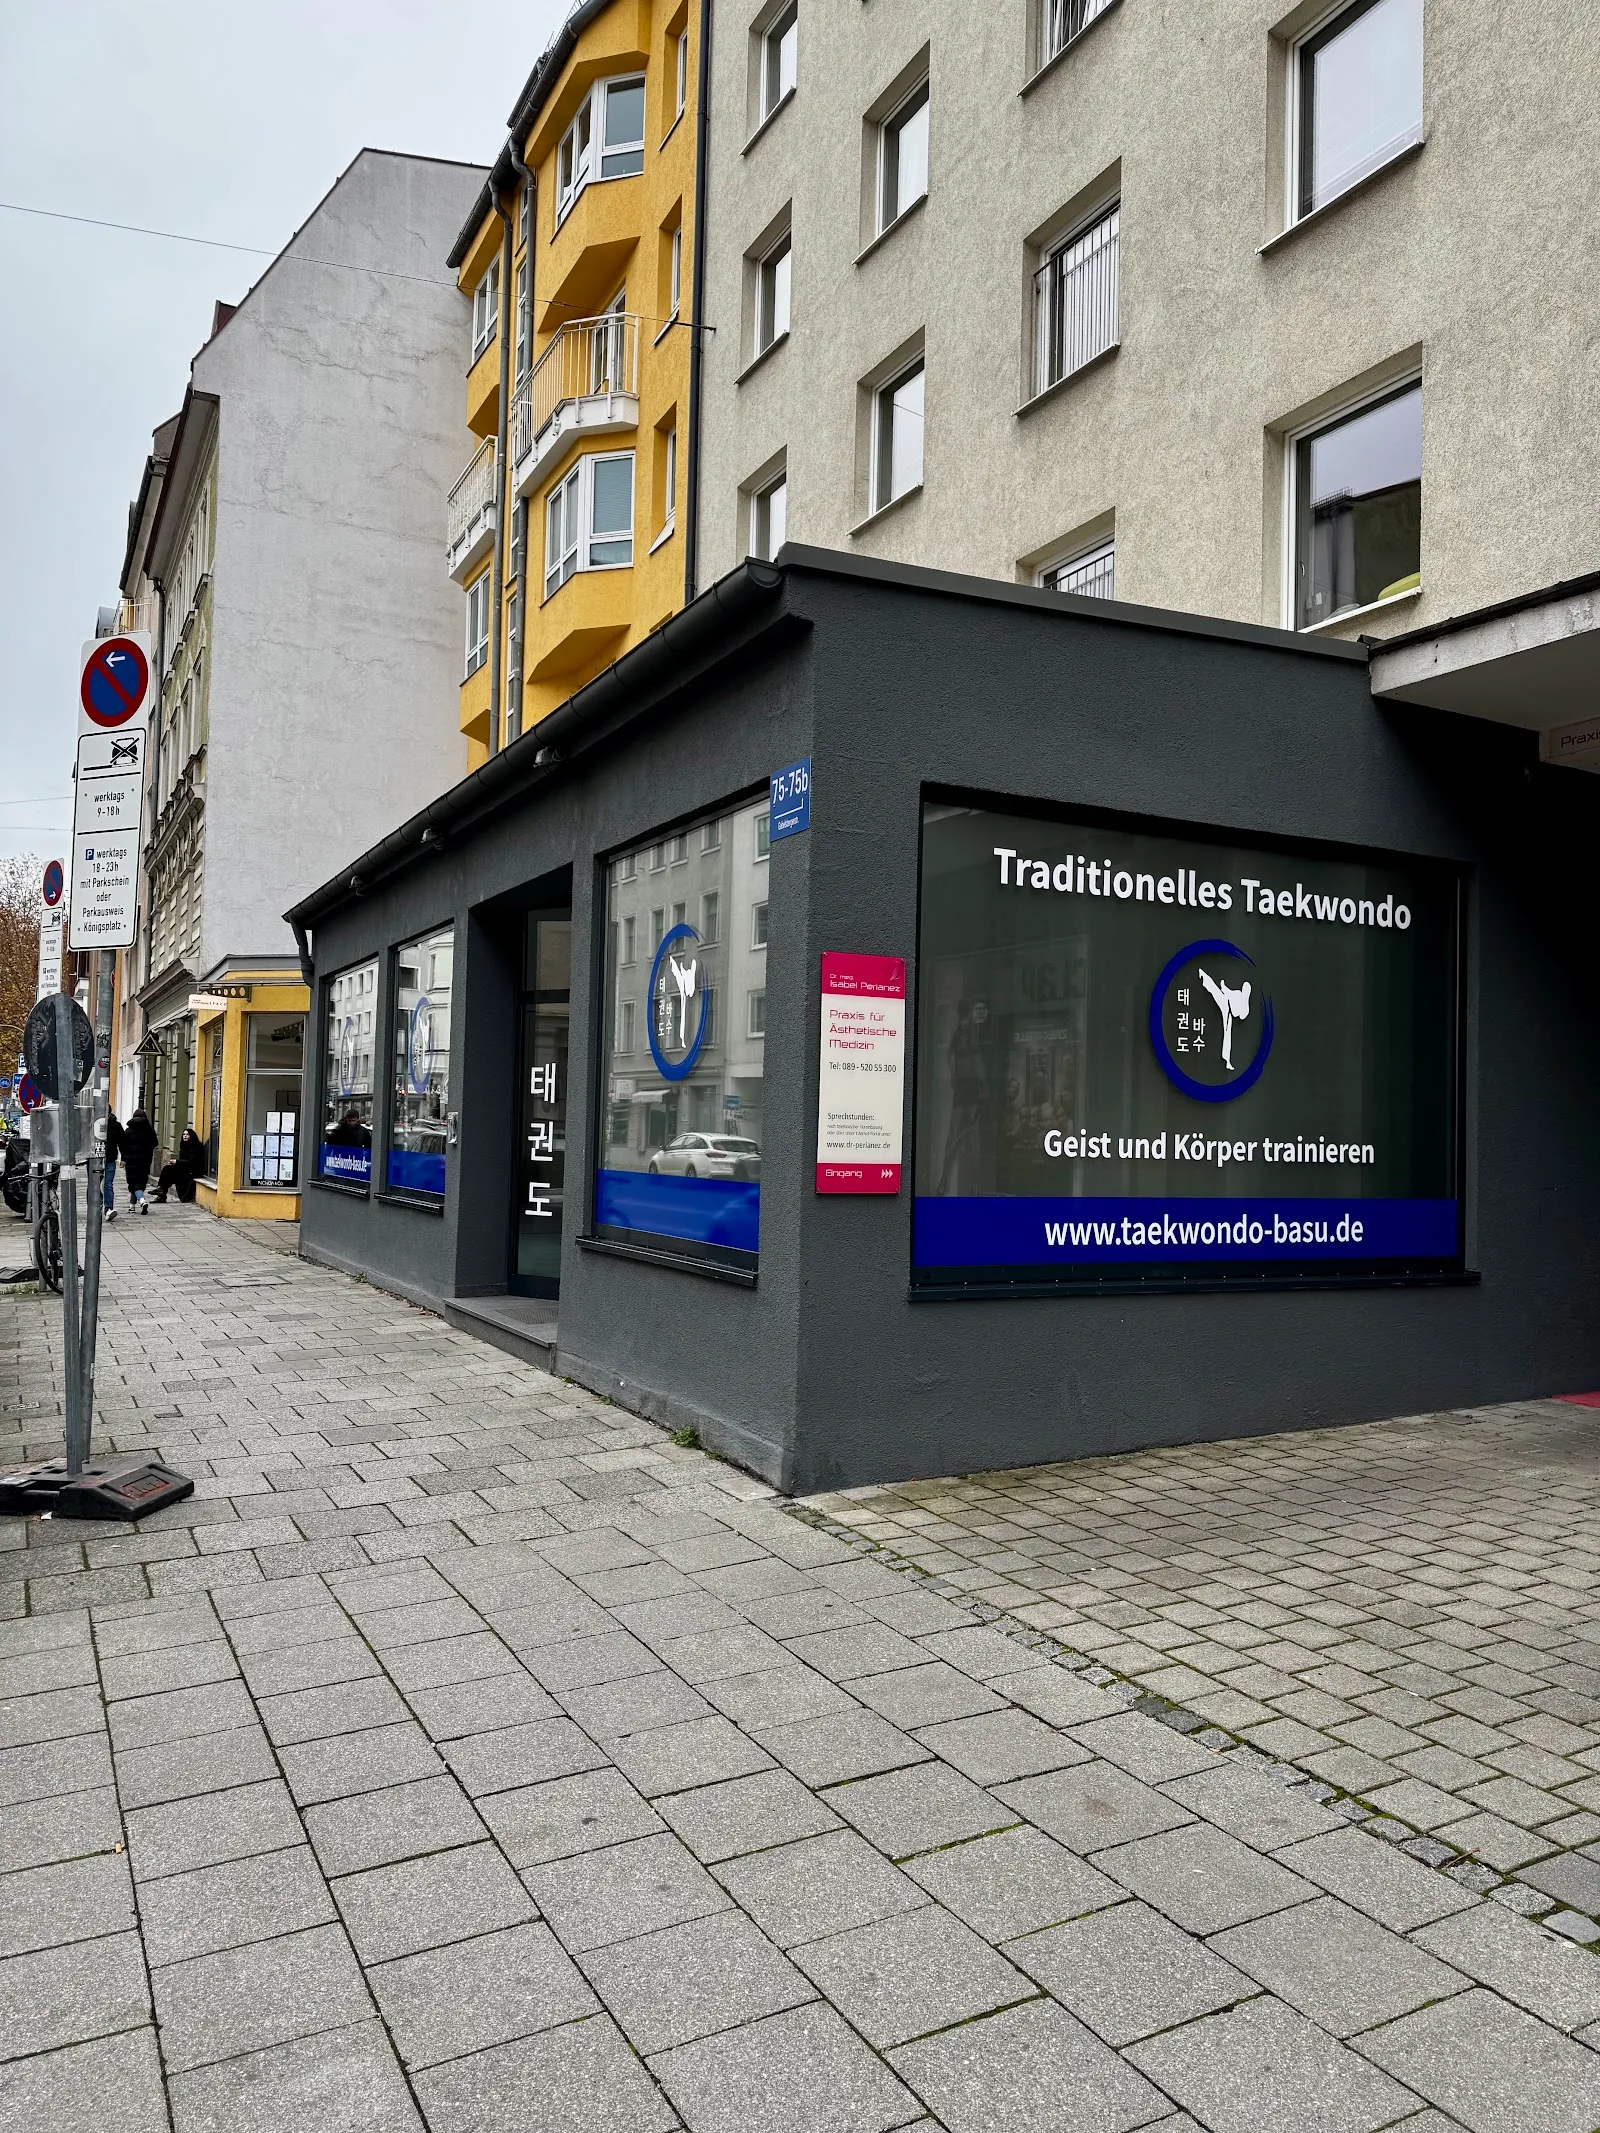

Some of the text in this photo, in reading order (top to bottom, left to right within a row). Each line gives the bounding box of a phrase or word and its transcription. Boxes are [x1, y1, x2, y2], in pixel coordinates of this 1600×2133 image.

[1561, 728, 1600, 748] Praxi
[772, 766, 808, 804] 75-75b
[94, 791, 125, 803] werktags
[97, 848, 127, 859] werktags
[80, 875, 129, 888] mit Parkschein
[994, 847, 1411, 930] Traditionelles Taekwondo
[96, 891, 112, 902] oder
[82, 905, 124, 917] Parkausweis
[83, 920, 121, 934] Königsplatz
[830, 980, 858, 989] Isabel
[829, 1009, 885, 1022] Praxis für
[1176, 988, 1190, 1052] 태권도
[829, 1022, 897, 1037] Ästhetische
[1192, 1017, 1206, 1053] 바수
[829, 1039, 875, 1050] Medizin
[829, 1061, 841, 1070] Tel:
[842, 1062, 856, 1071] 089
[827, 1112, 875, 1121] Sprechstunden:
[524, 1062, 557, 1217] 태권도
[826, 1141, 891, 1150] www.dr-perianez.de
[1044, 1129, 1375, 1168] Geist und Körper trainieren
[825, 1169, 863, 1178] Eingang
[1045, 1213, 1364, 1246] www.taekwondo-basu.de
